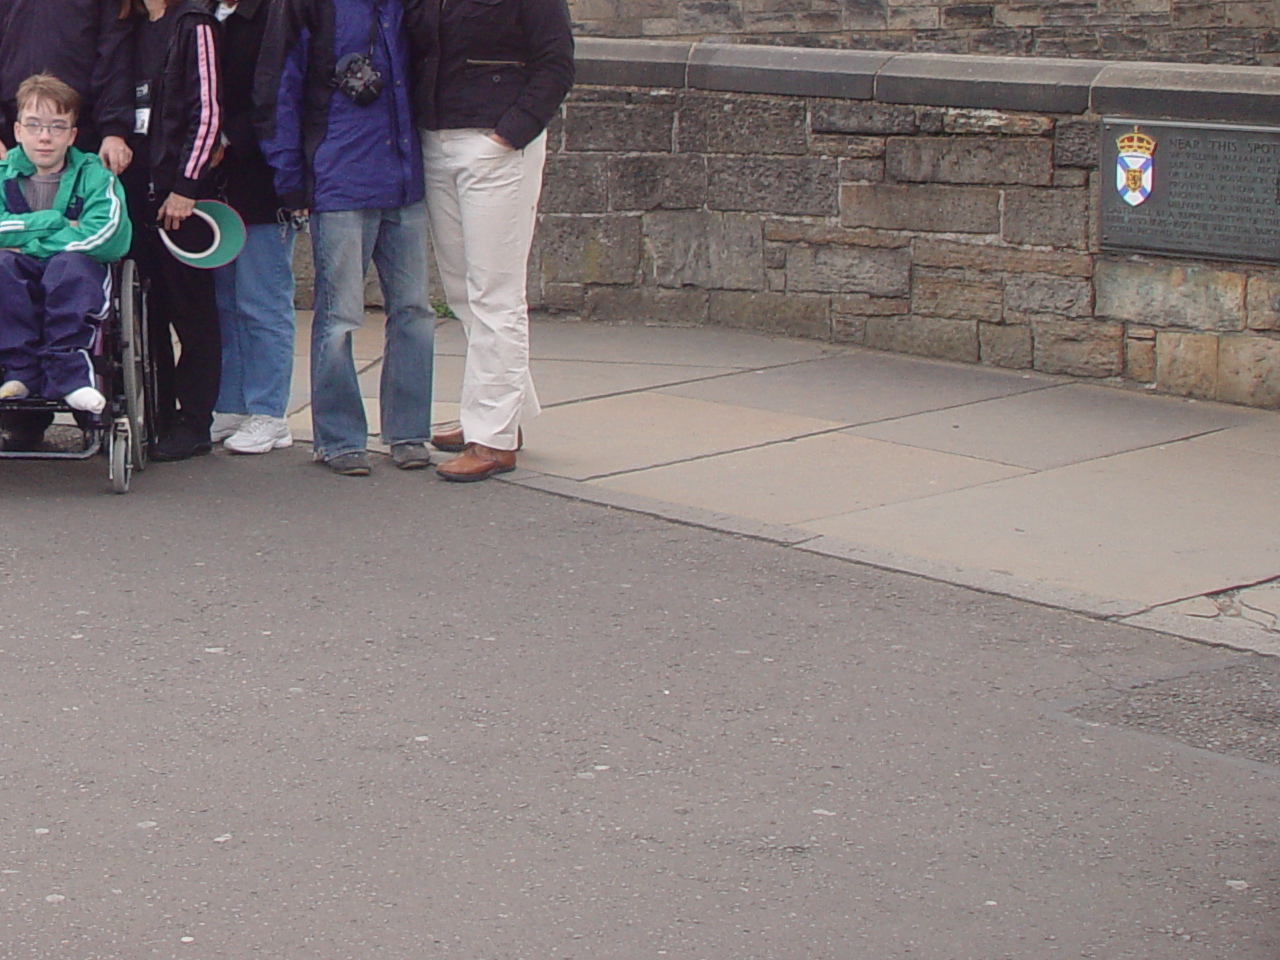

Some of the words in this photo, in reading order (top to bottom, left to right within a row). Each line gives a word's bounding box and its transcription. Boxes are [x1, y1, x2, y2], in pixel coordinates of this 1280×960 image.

[1169, 138, 1200, 150] NEAR
[1209, 141, 1237, 153] THIS
[1247, 144, 1278, 156] SPOT
